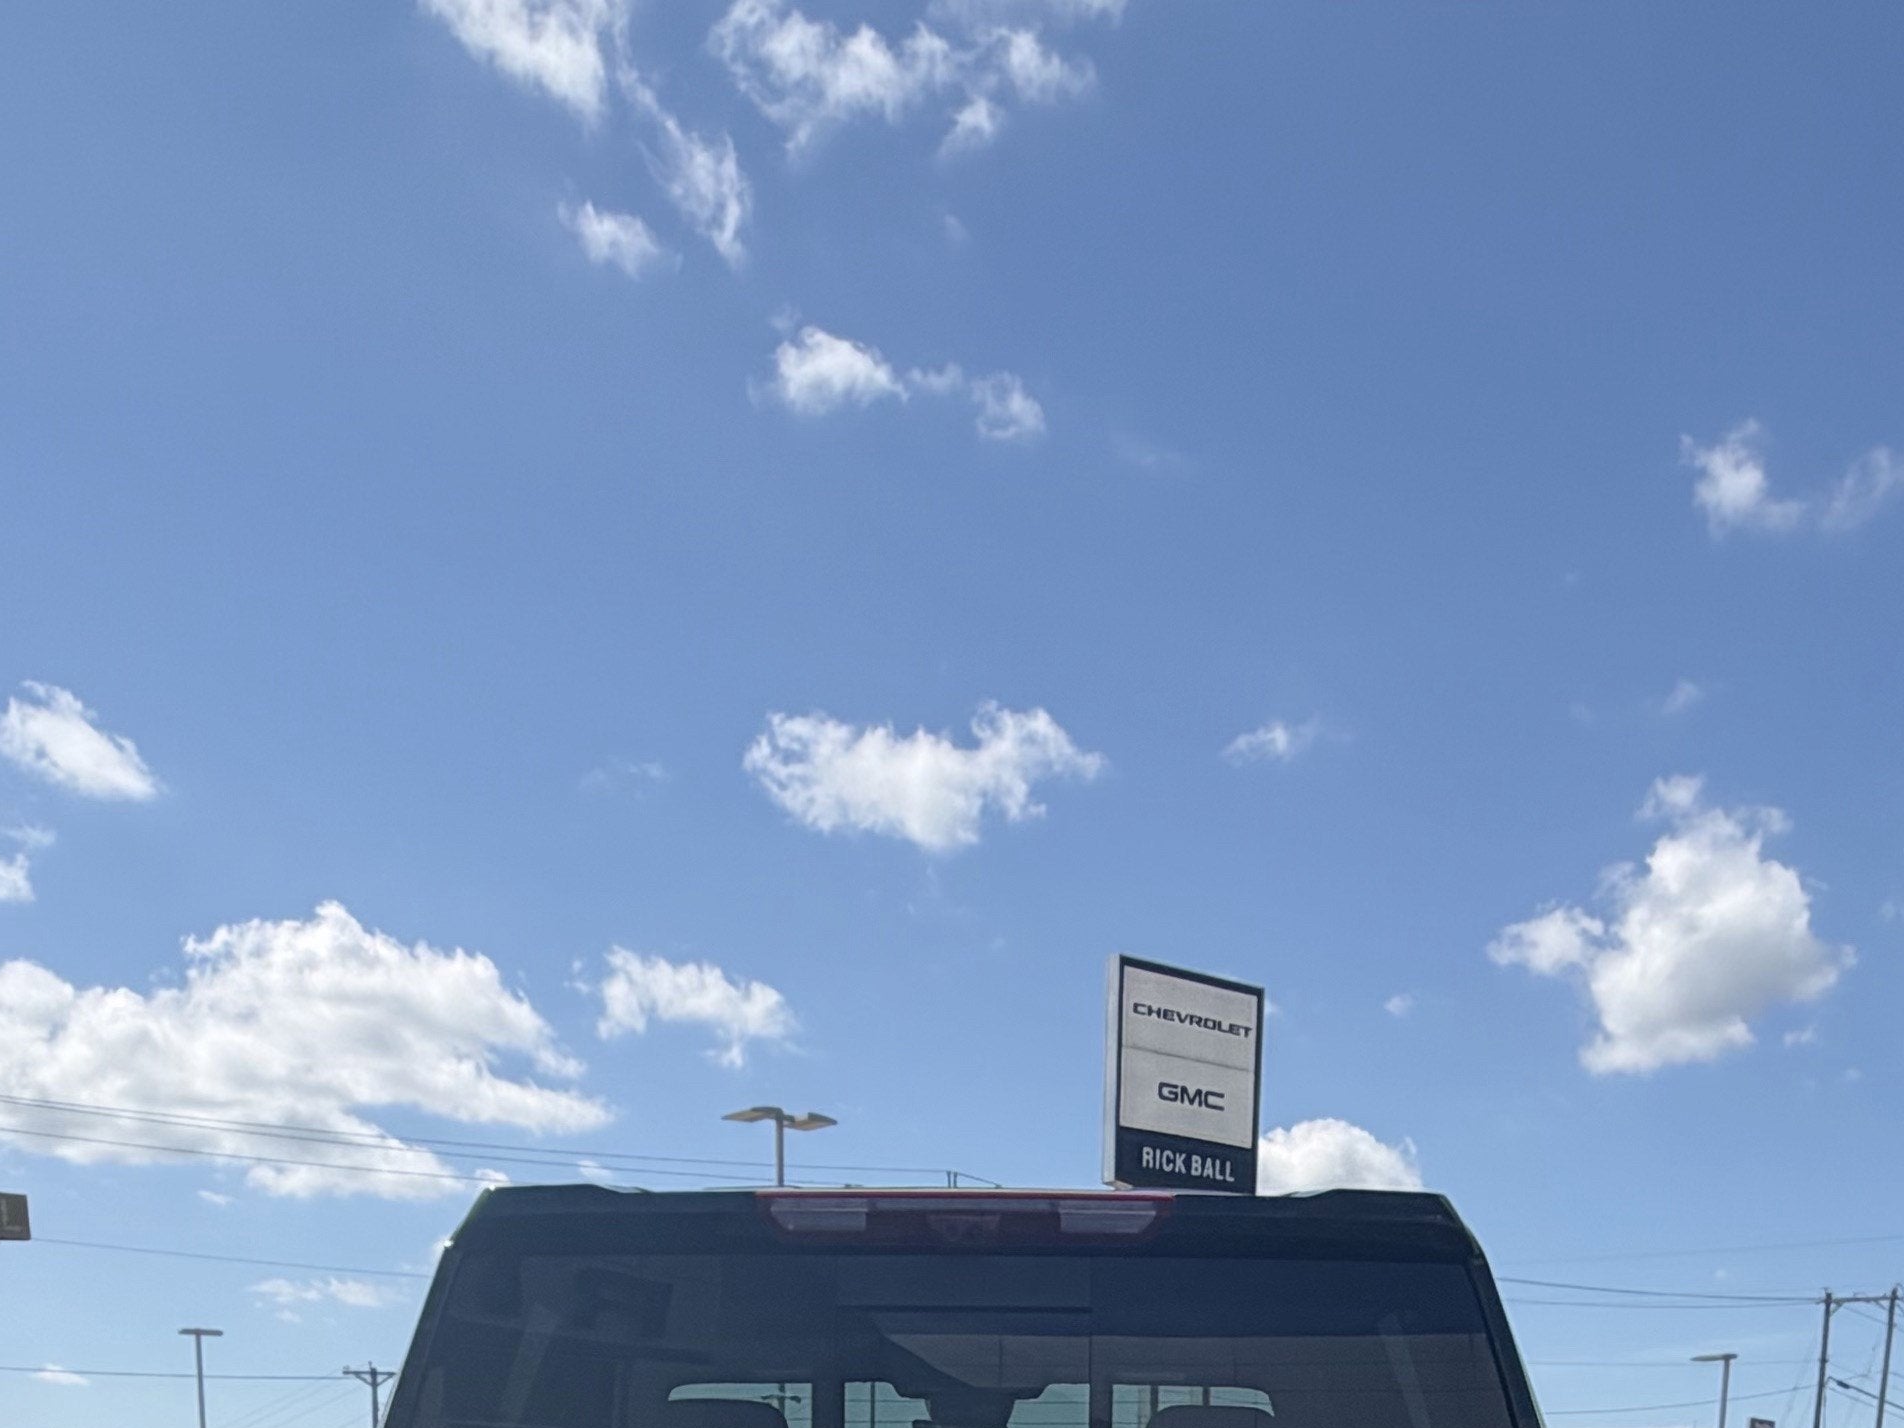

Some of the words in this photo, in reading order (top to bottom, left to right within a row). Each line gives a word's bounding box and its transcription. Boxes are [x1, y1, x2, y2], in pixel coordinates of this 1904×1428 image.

[1133, 1002, 1253, 1039] CHEVROLET
[1158, 1081, 1226, 1112] GMC
[1142, 1146, 1187, 1175] RICK
[1191, 1155, 1235, 1182] BALL
